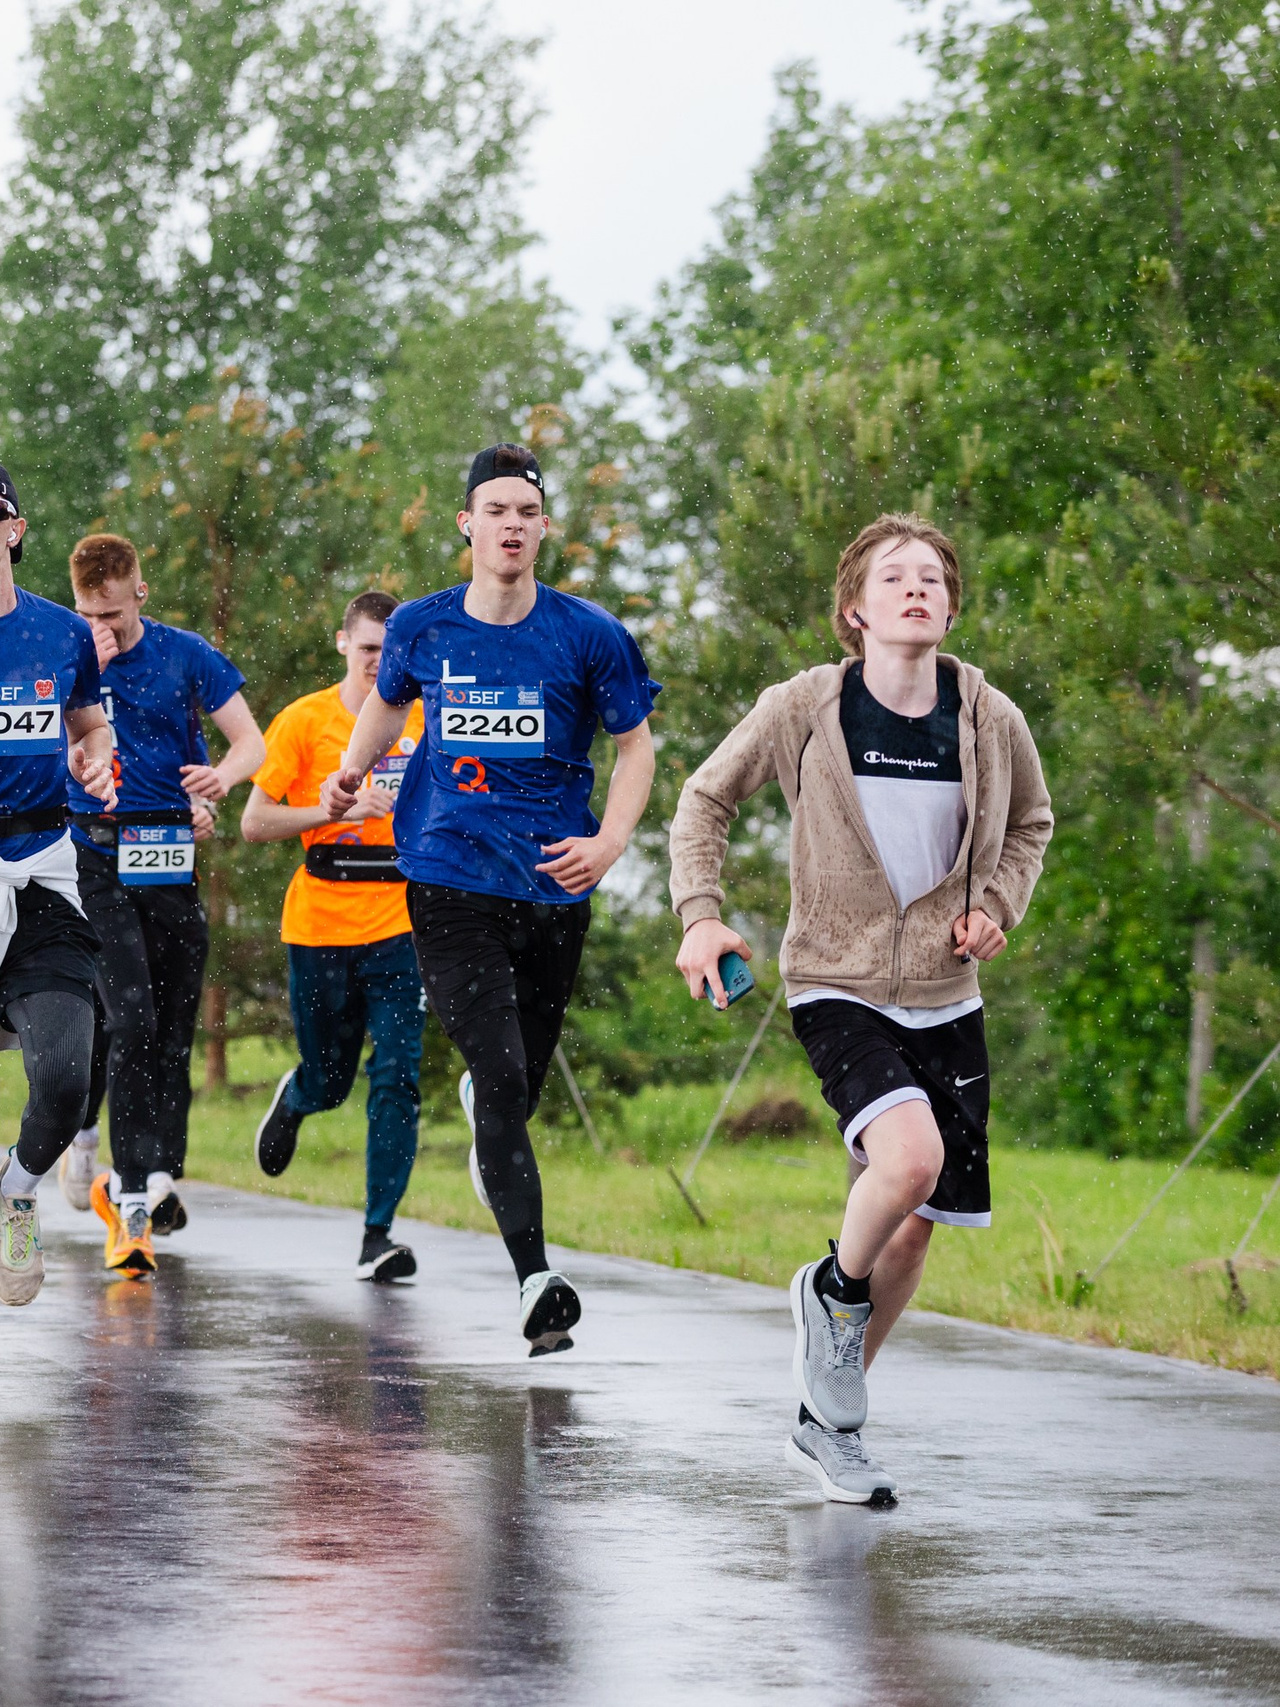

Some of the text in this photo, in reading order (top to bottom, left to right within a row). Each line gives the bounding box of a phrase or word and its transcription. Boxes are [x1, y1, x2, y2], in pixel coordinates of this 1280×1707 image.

[446, 713, 539, 737] 2240
[863, 750, 938, 771] Champion
[128, 850, 186, 867] 2215
